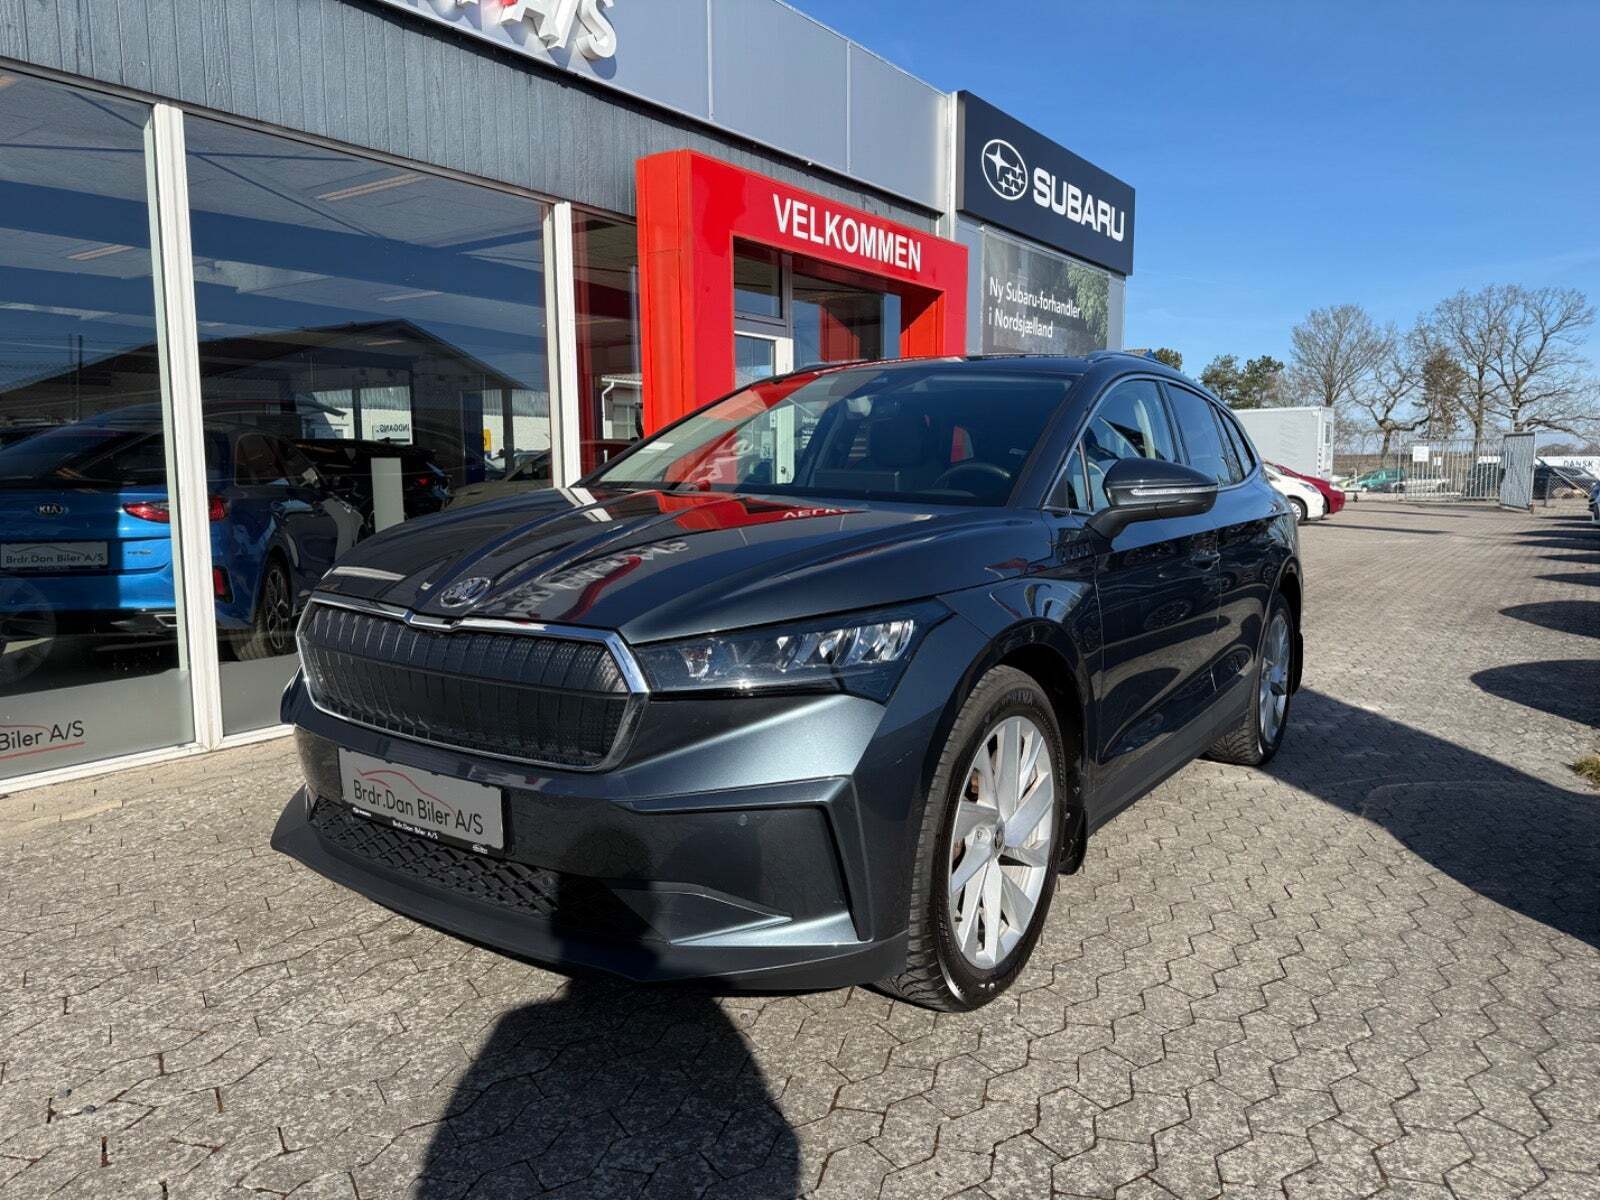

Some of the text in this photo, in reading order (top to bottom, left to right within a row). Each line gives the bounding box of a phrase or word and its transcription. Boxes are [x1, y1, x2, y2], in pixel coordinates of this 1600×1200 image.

[1033, 167, 1125, 242] SUBARU
[773, 193, 921, 272] VELKOMMEN
[989, 276, 1080, 319] Ny Subaru-forhandler
[988, 306, 1054, 338] i Nordsjælland
[39, 505, 59, 514] KIA
[57, 553, 81, 562] Biler
[84, 552, 104, 561] A/S
[49, 720, 84, 743] A/S
[353, 779, 414, 817] Brdr.Dan
[417, 798, 450, 826] Biler
[455, 809, 484, 835] A/S
